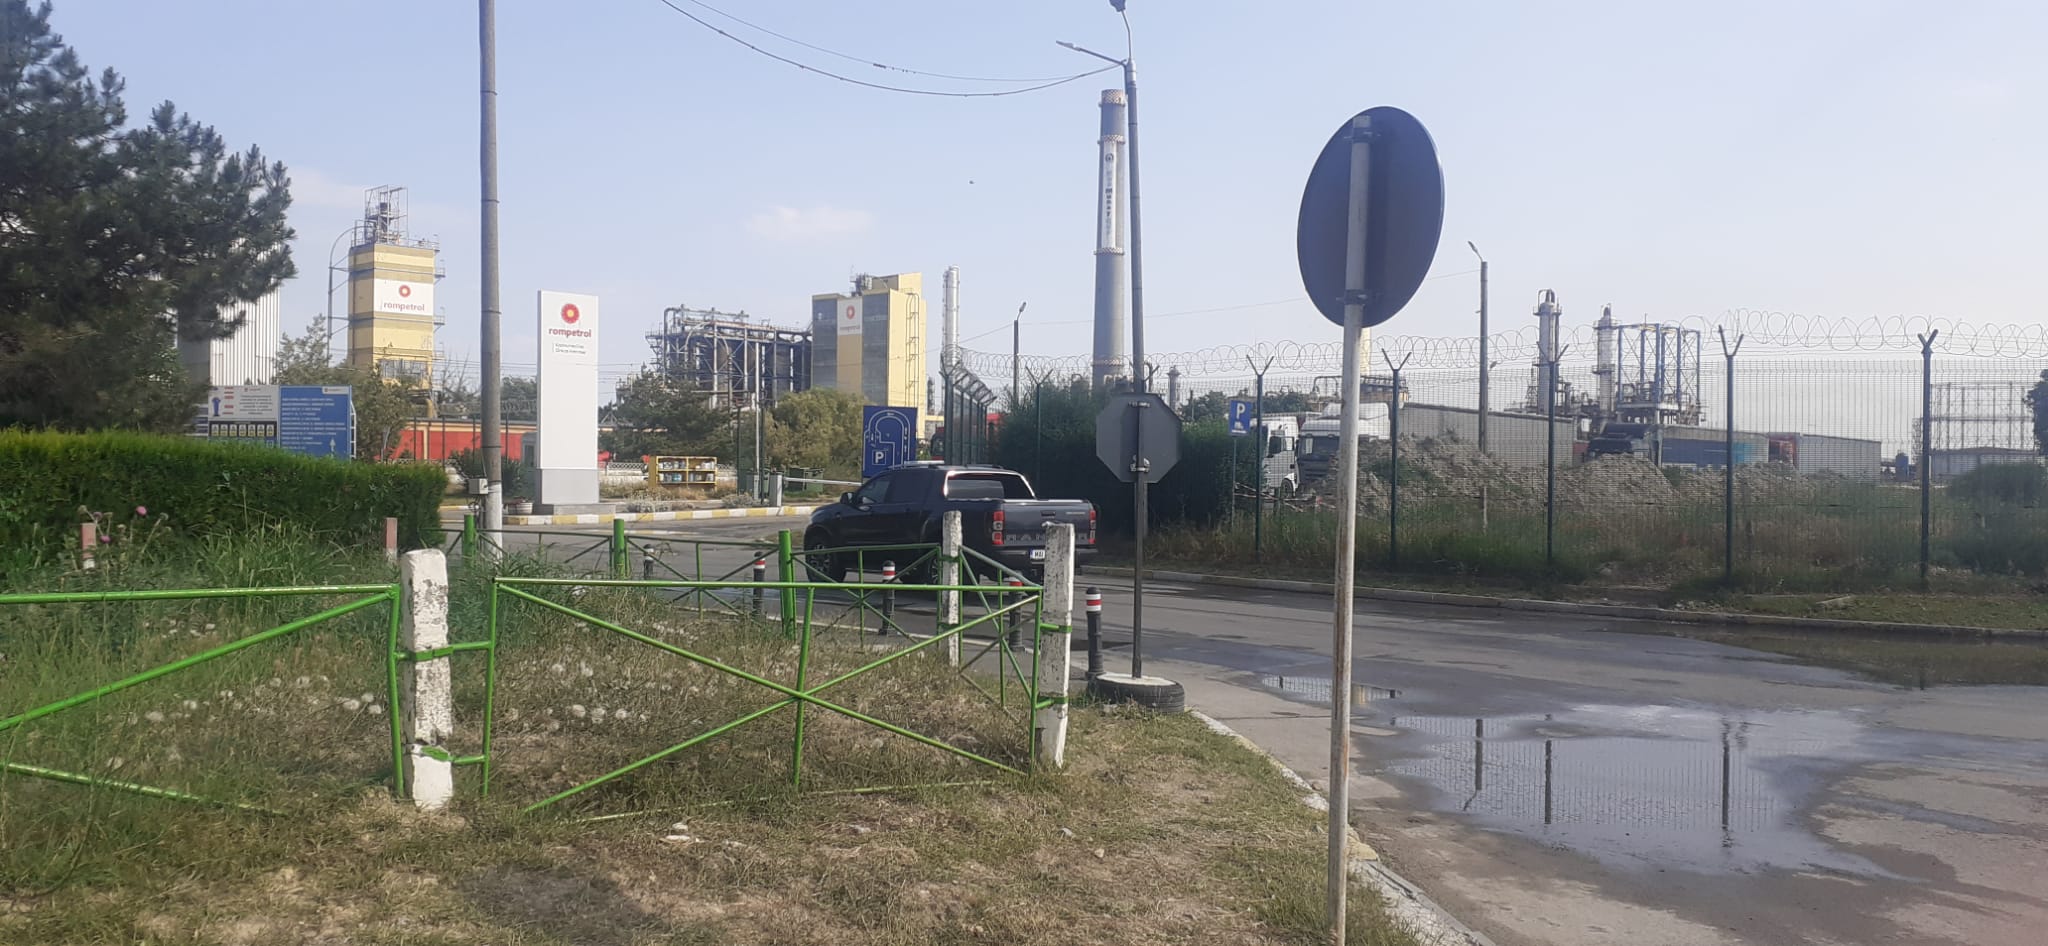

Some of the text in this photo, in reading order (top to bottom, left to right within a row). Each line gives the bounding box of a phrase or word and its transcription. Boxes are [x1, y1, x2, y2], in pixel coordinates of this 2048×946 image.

[383, 302, 425, 312] rompetrol
[548, 328, 592, 339] rompetrol
[1236, 402, 1246, 419] P
[875, 451, 884, 464] P
